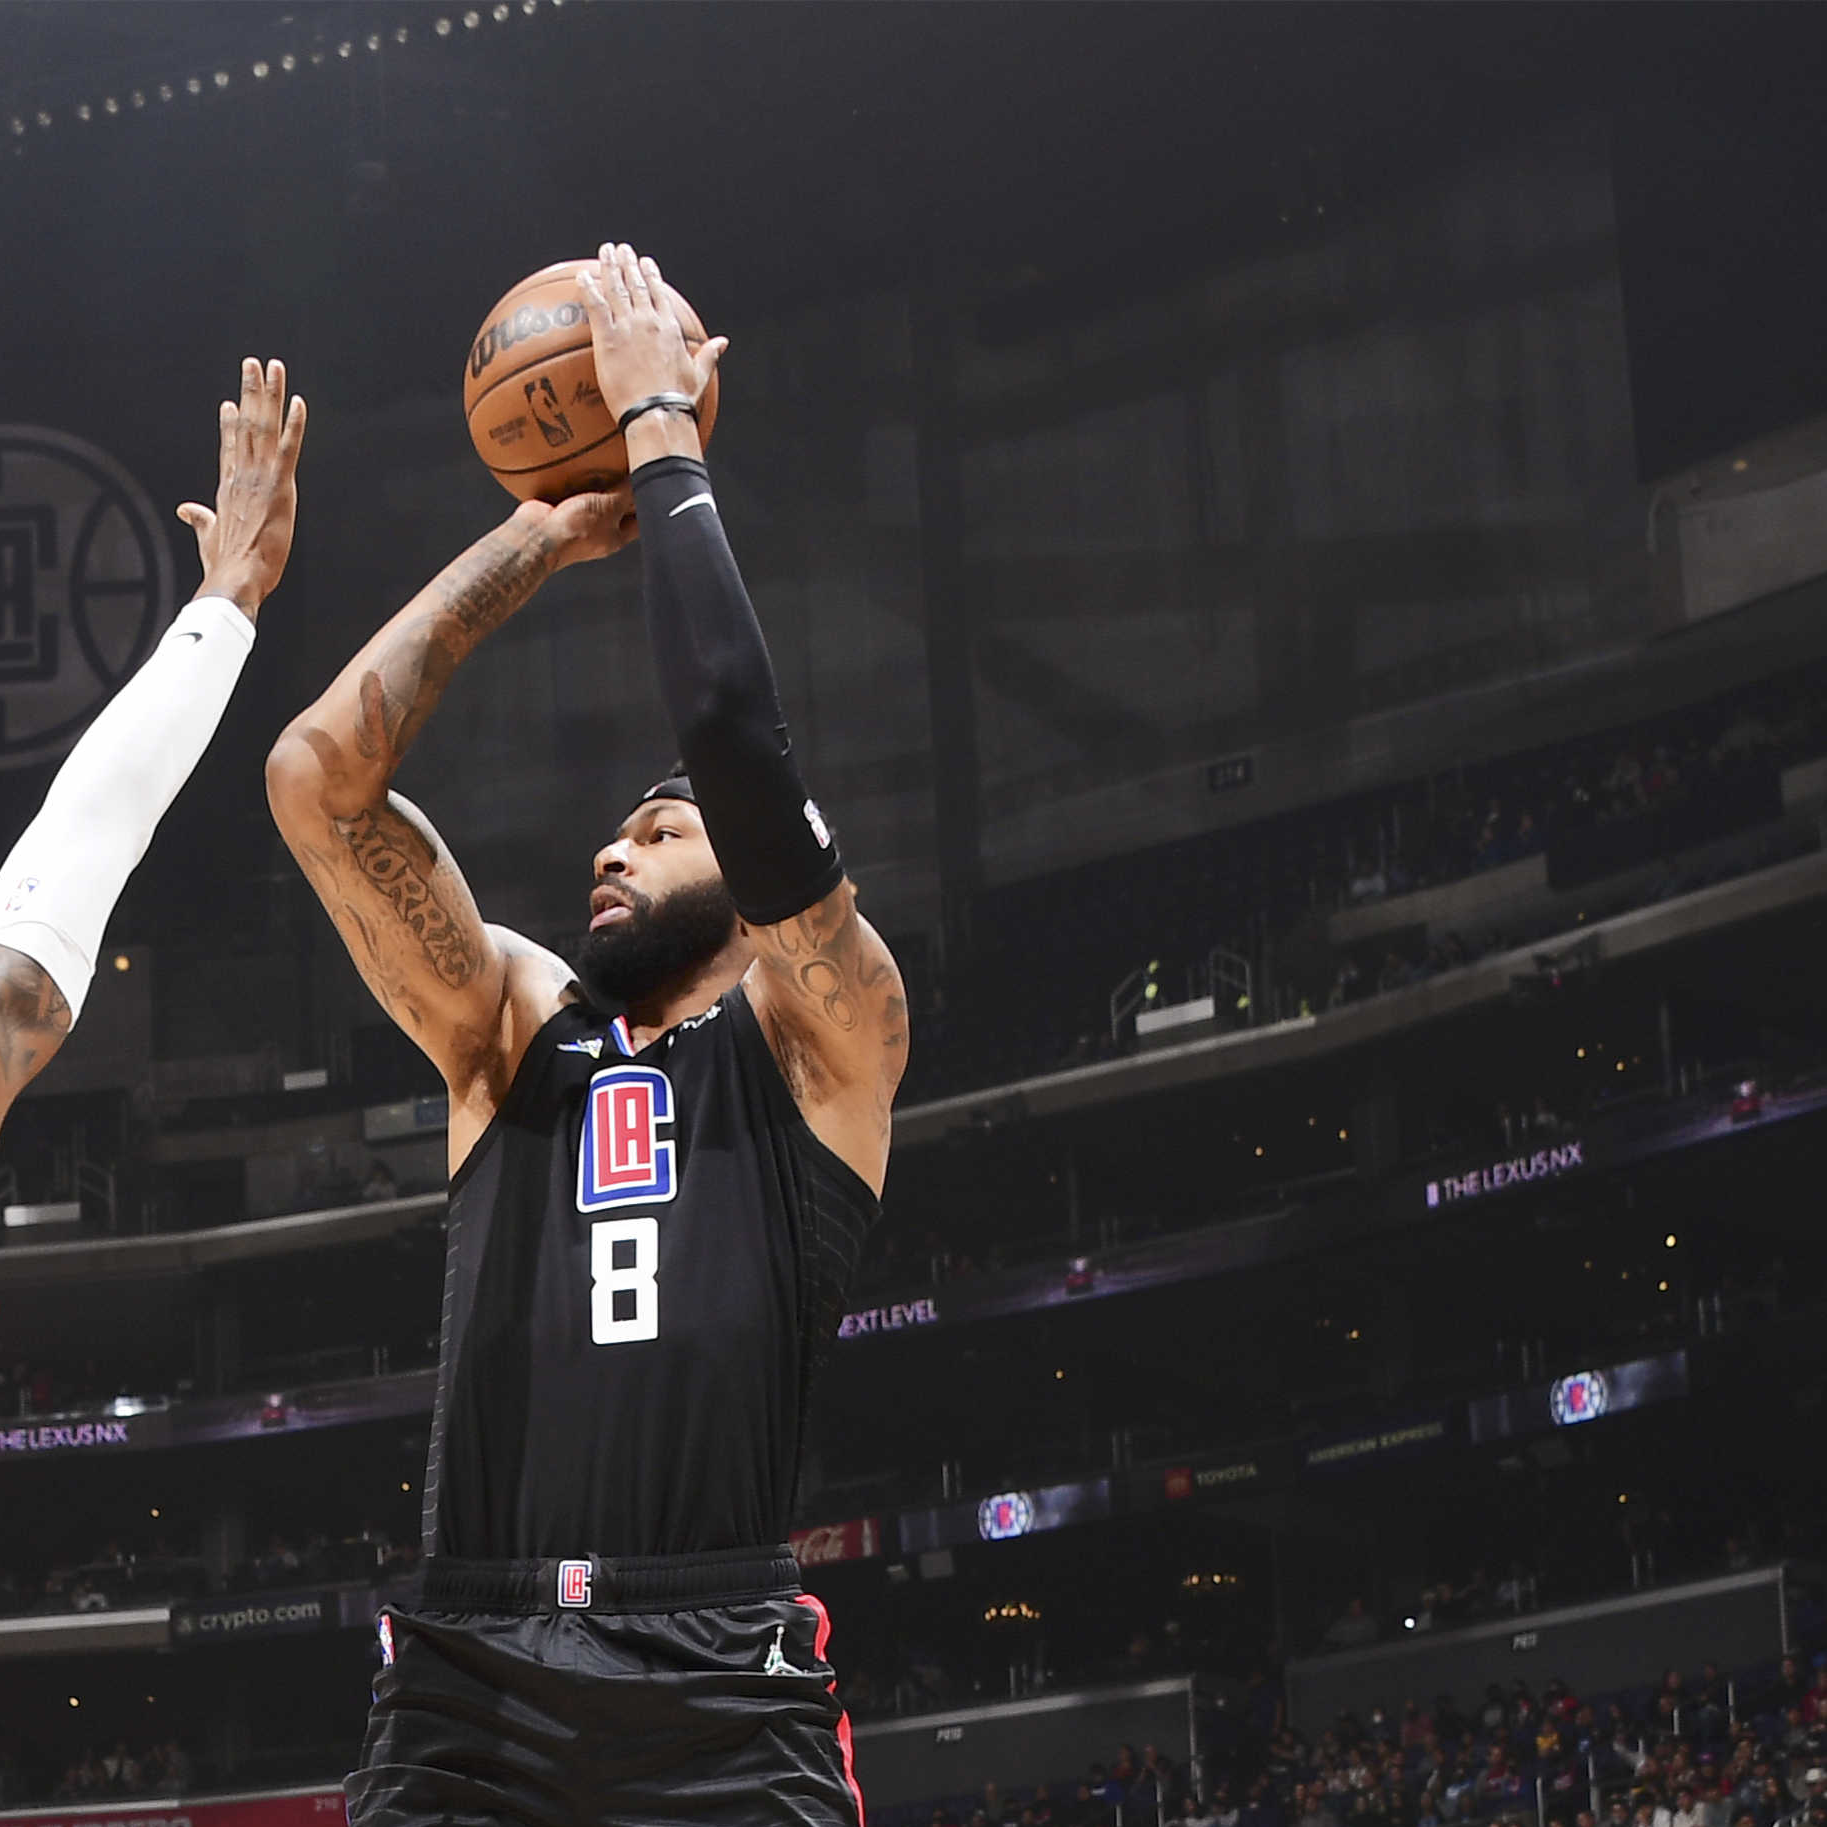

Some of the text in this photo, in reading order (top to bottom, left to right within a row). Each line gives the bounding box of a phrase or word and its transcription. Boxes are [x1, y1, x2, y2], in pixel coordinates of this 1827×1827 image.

[1443, 1140, 1583, 1201] THE LEXUS NX
[591, 1217, 659, 1345] 8
[880, 1298, 938, 1331] LEVEL
[28, 1423, 94, 1450] LEXUS
[95, 1420, 129, 1444] NX
